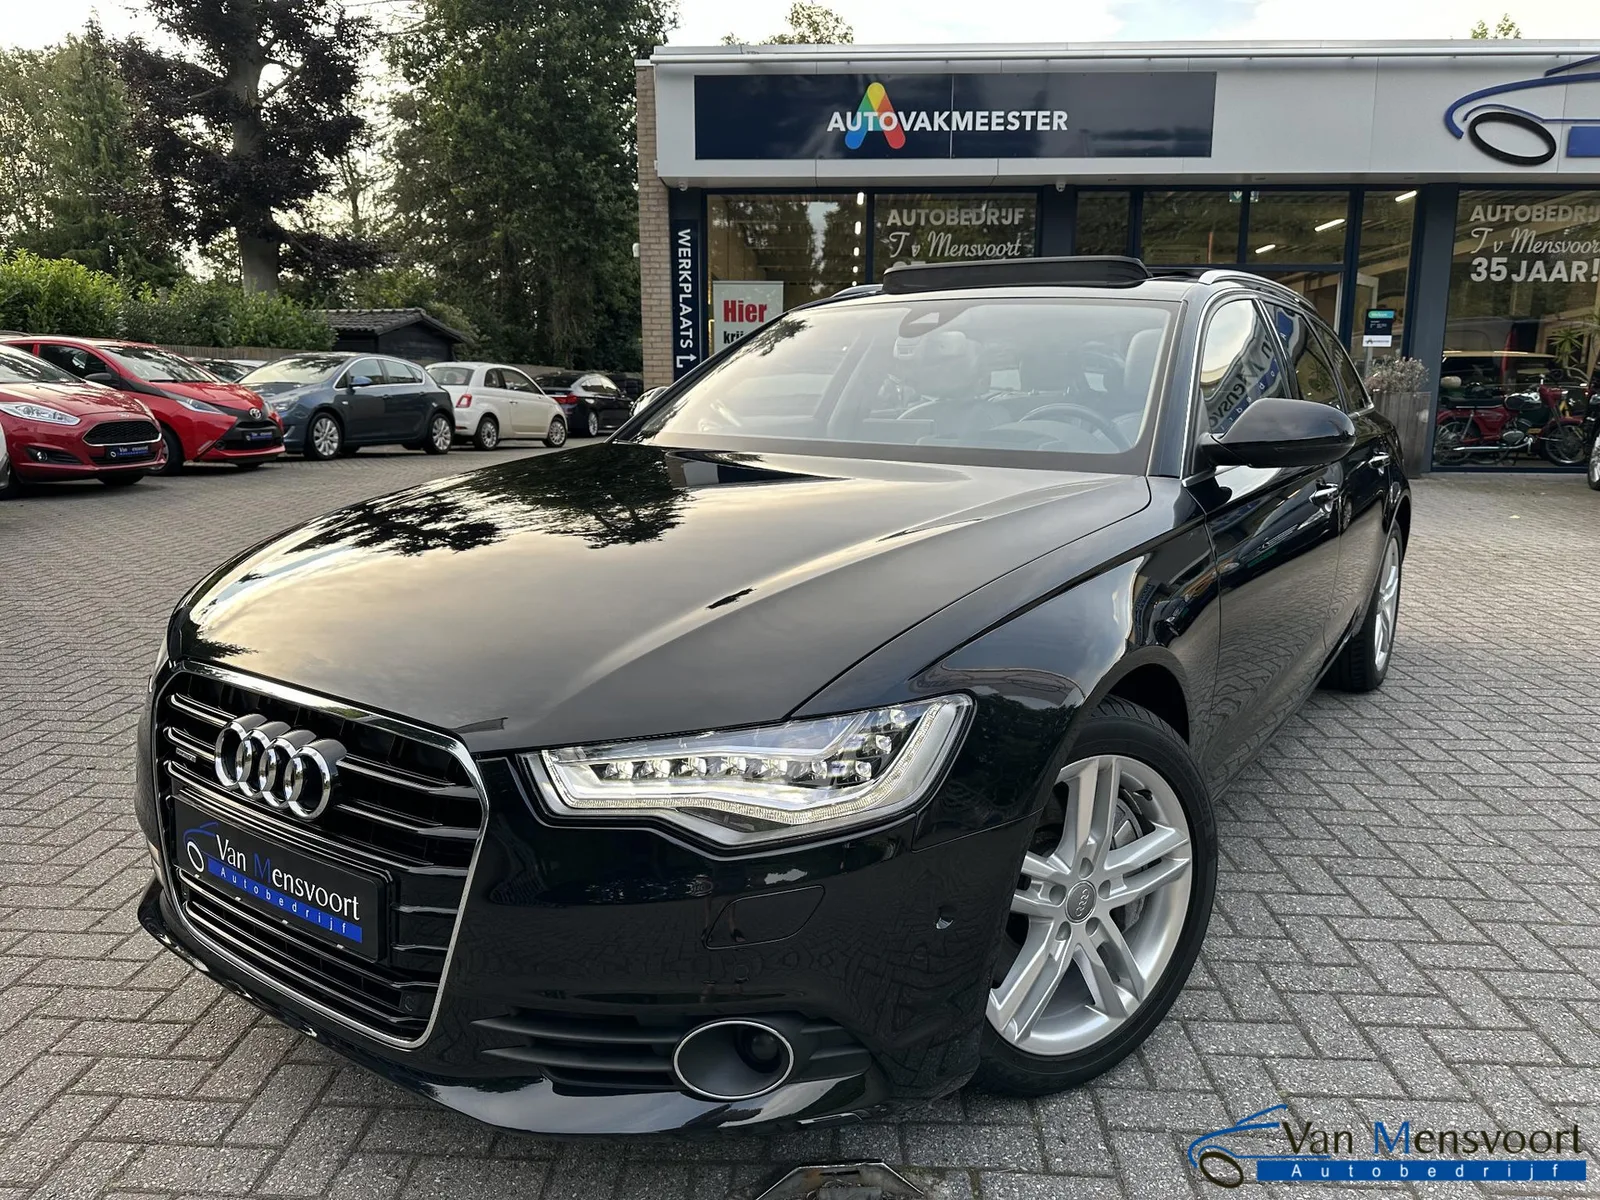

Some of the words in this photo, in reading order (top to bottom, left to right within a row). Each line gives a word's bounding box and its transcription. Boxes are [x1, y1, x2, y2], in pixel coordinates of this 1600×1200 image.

[827, 111, 1068, 131] AUTOVAKMEESTER
[886, 208, 1026, 226] AUTOBEDRIJF
[928, 230, 1021, 257] Mensvoort
[1470, 227, 1493, 254] T
[1493, 240, 1503, 254] v
[1470, 257, 1508, 282] 35
[1511, 258, 1600, 283] JAAR!
[677, 229, 693, 349] WERKPLAATS
[723, 300, 767, 323] Hier
[216, 834, 246, 871] Van
[254, 853, 360, 921] Mensvoort
[220, 867, 347, 934] Autobedrijf
